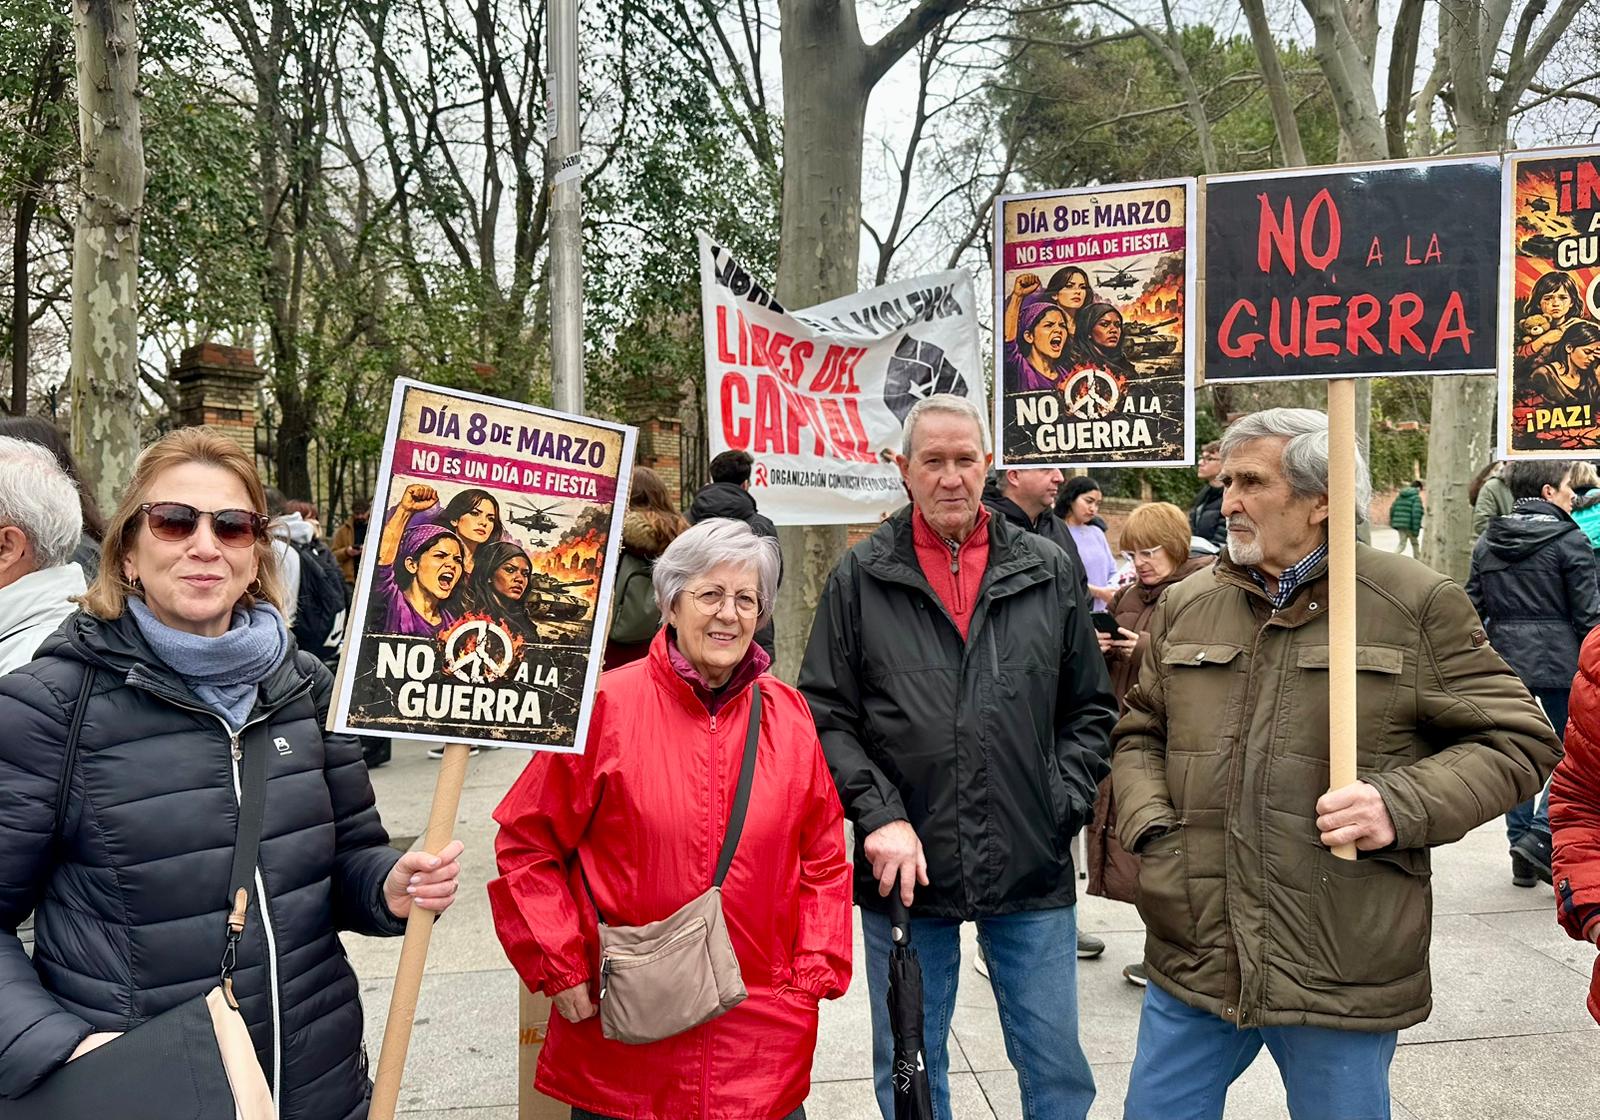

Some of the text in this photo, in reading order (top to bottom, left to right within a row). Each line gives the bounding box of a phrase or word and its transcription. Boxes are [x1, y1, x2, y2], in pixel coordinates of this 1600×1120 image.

[1017, 199, 1171, 235] DÍA 8 DE MARZO
[1256, 187, 1443, 277] NO A LA
[1016, 232, 1169, 265] NO ES UN DÍA DE FIESTA
[1217, 291, 1475, 361] GUERRA
[809, 344, 868, 394] DEL
[1016, 394, 1162, 426] NO A LA
[1526, 404, 1592, 433] ¡PAZ!
[418, 404, 606, 469] DÍA 8 DE MARZO
[1035, 418, 1153, 453] GUERRA
[411, 448, 598, 497] NO ES UN DÍA DE FIESTA
[770, 468, 827, 488] ORGANIZACIÓN
[376, 642, 559, 688] NO A LA
[398, 681, 543, 725] GUERRA
